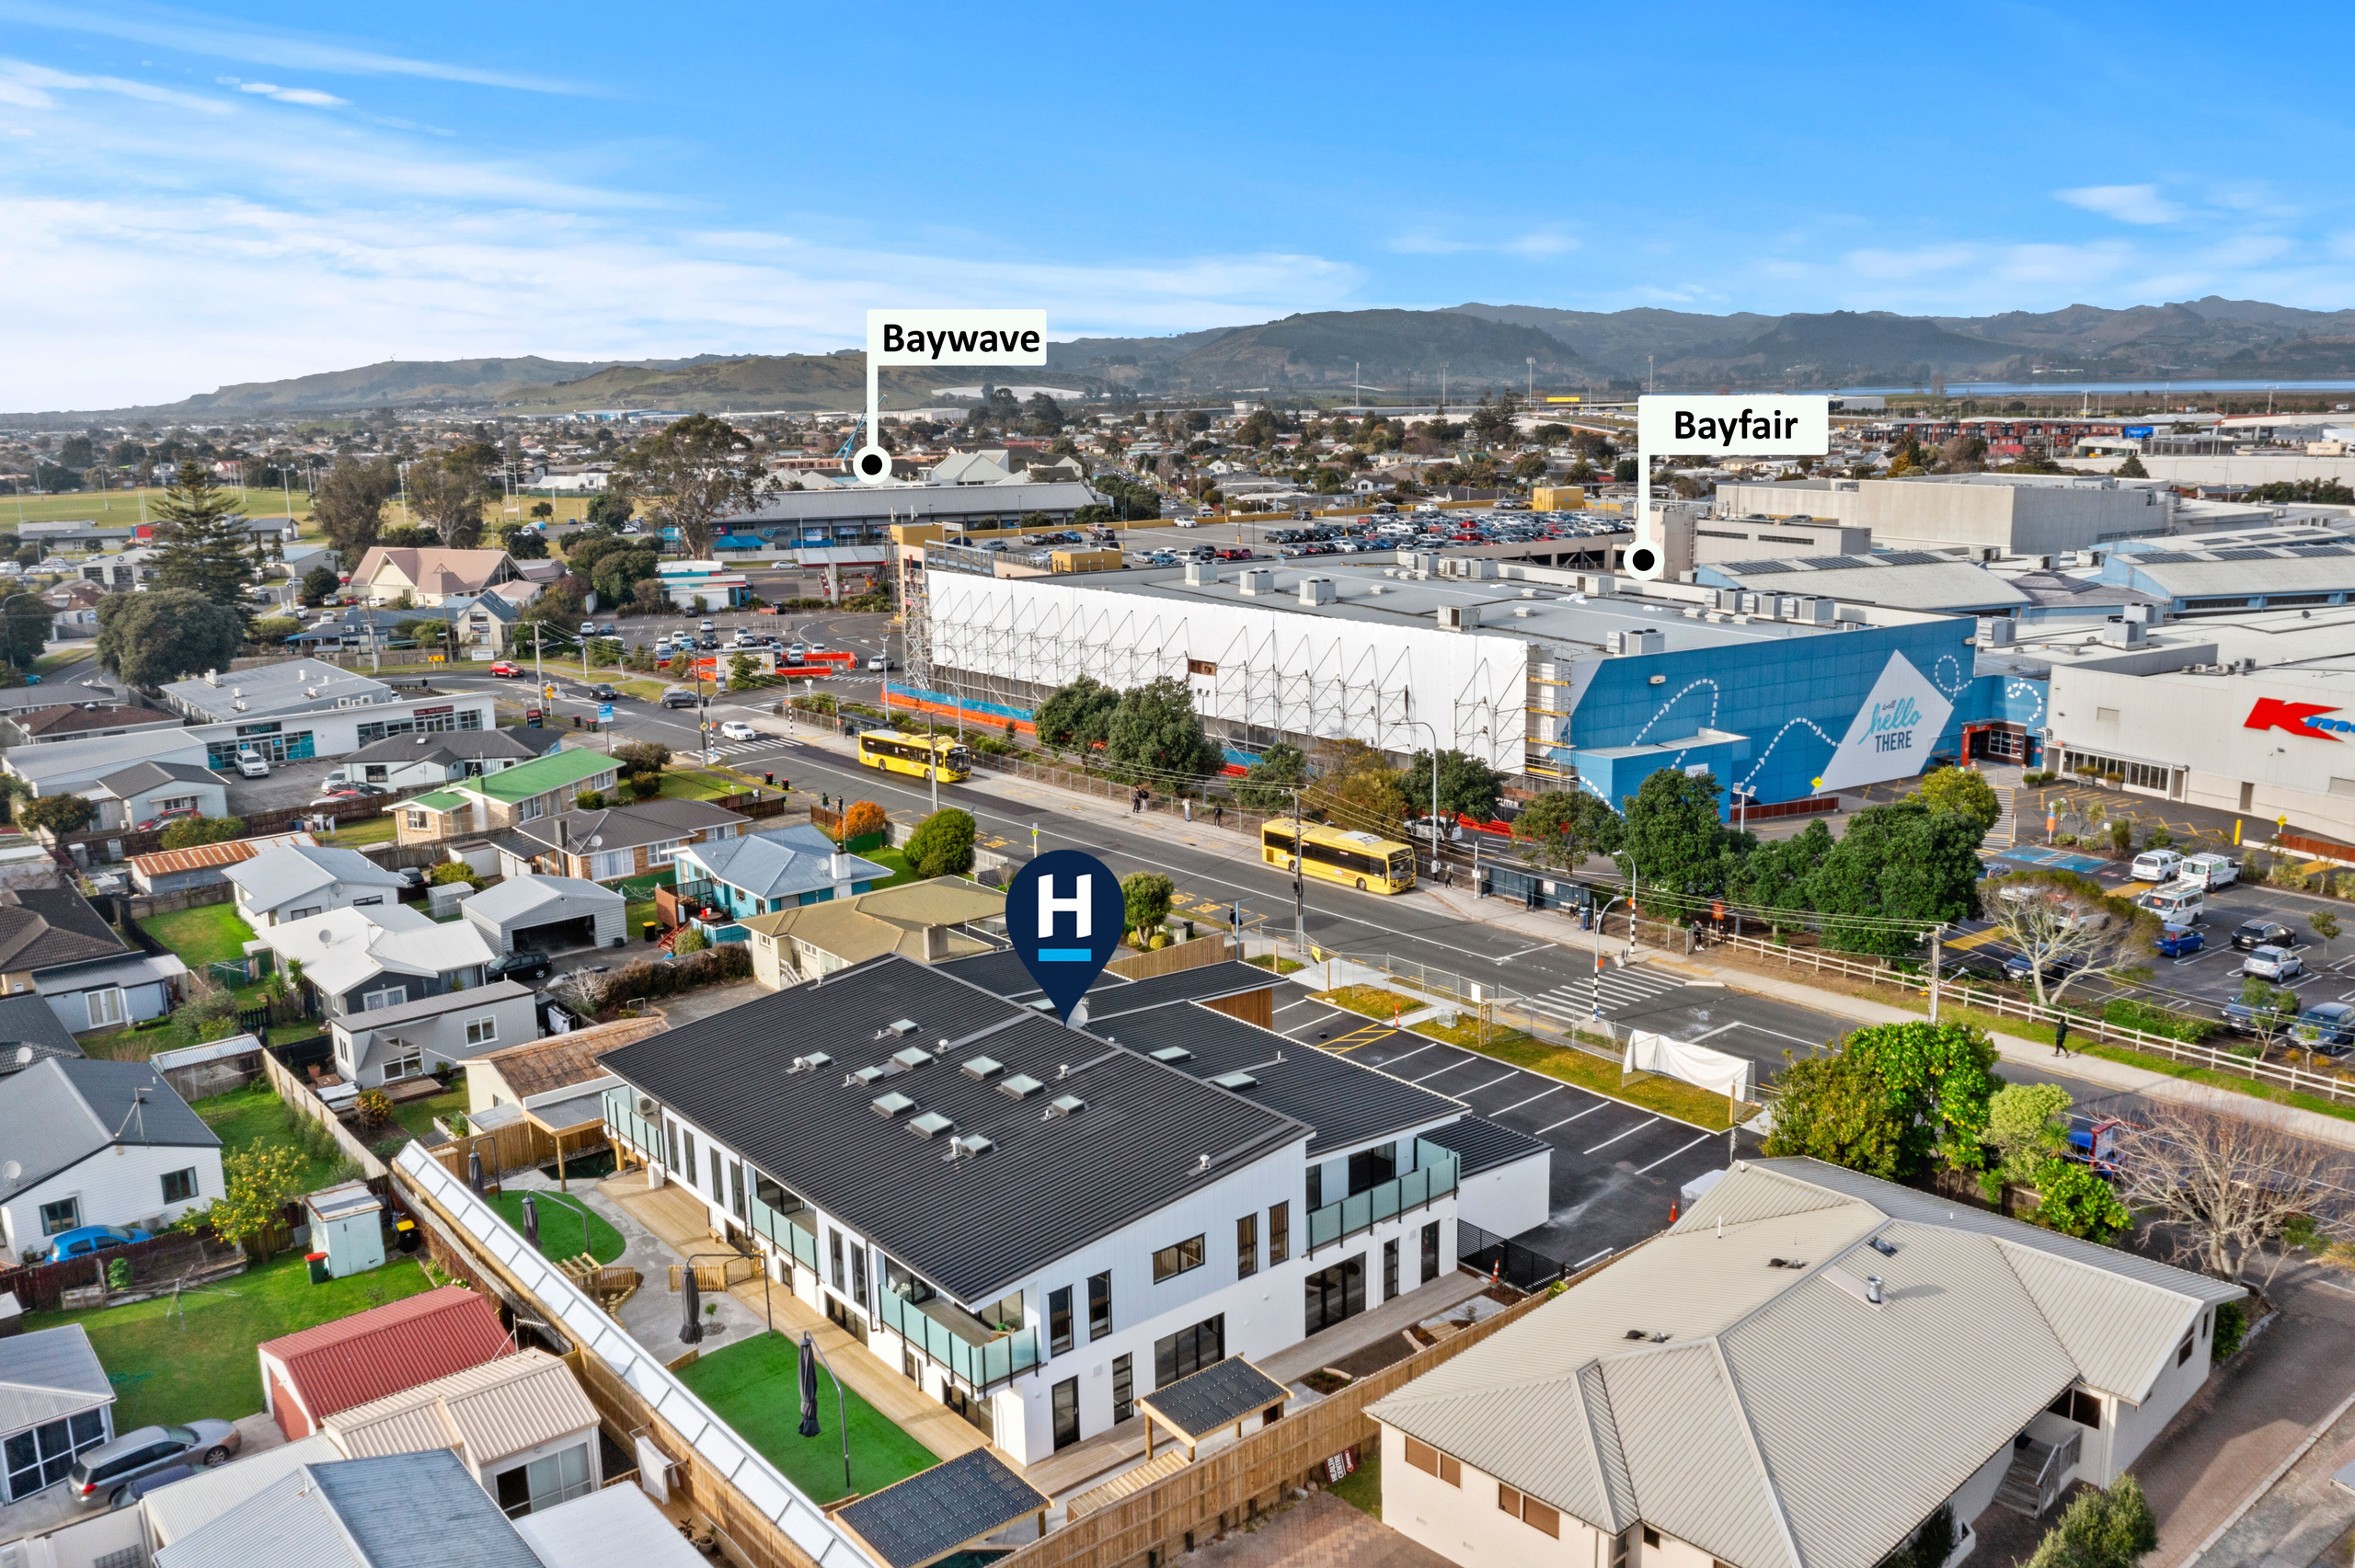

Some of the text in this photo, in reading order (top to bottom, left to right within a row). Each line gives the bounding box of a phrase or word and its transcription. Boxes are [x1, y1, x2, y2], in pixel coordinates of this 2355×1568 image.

[1858, 696, 1923, 745] hello
[1875, 730, 1913, 753] THERE
[1327, 1457, 1338, 1482] HEALTH
[1334, 1453, 1345, 1479] CENTRE
